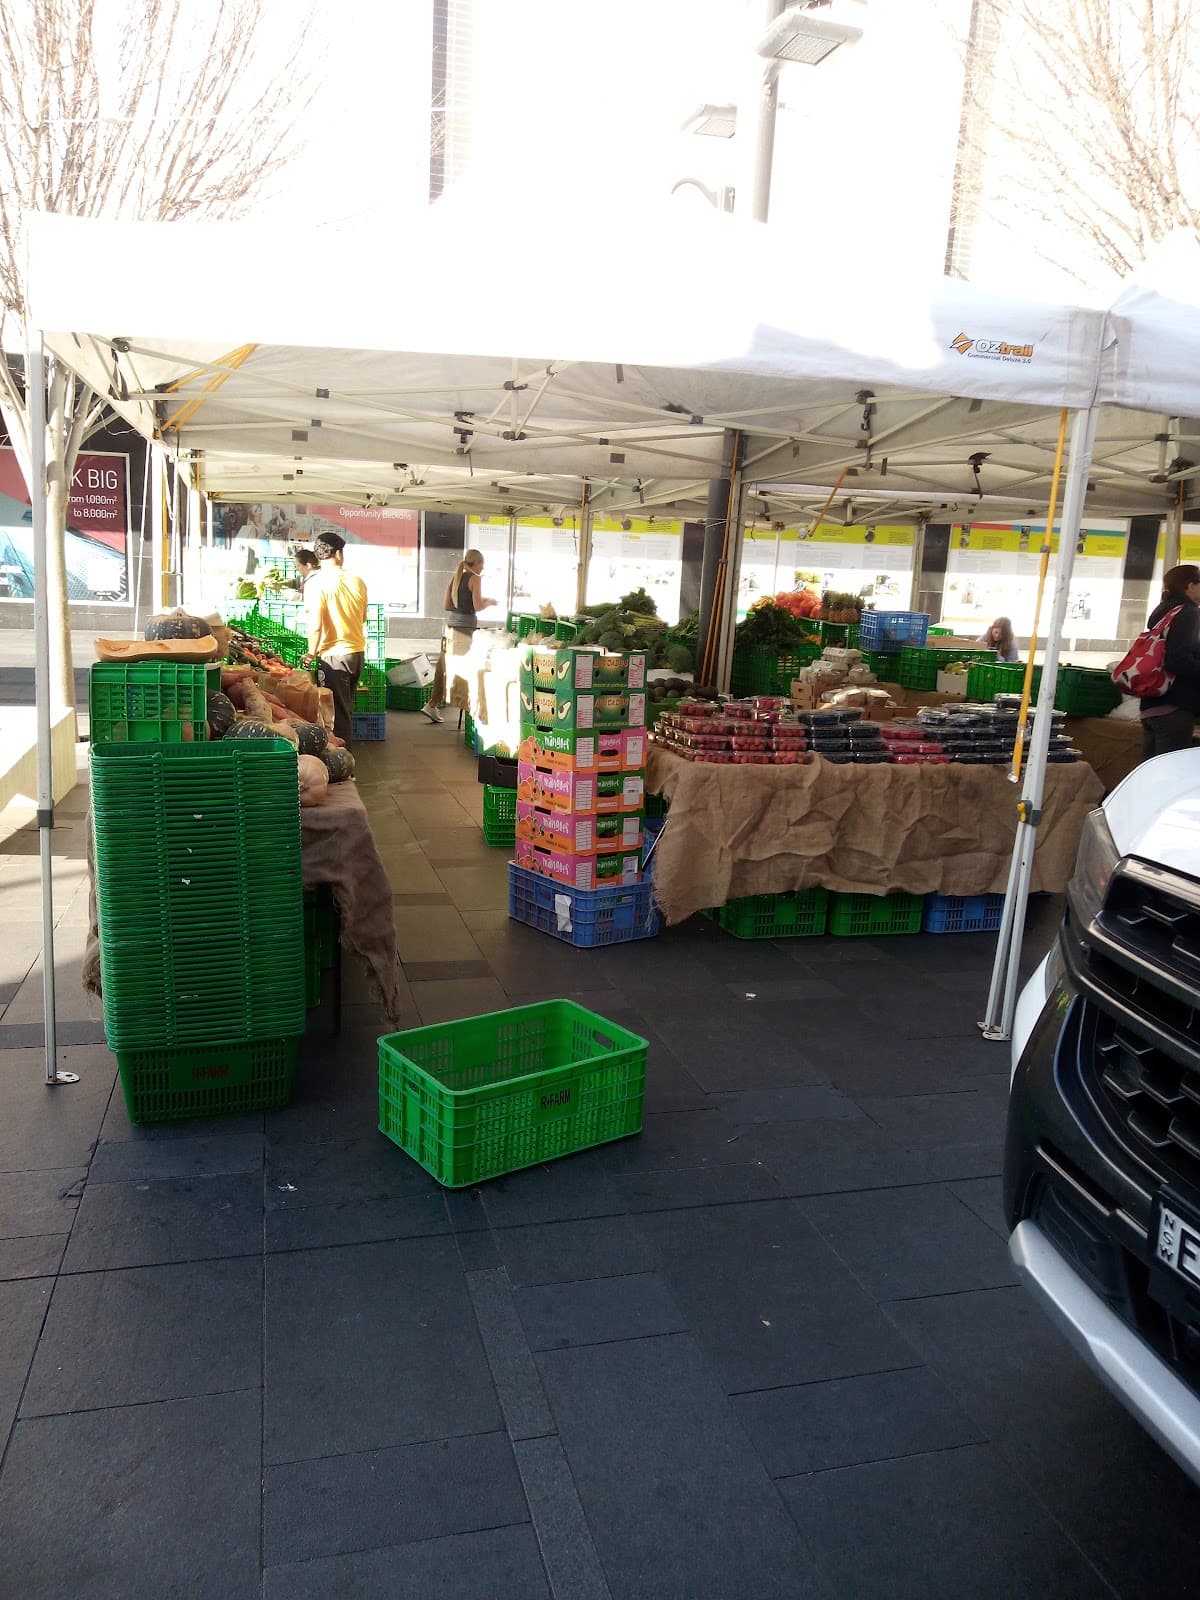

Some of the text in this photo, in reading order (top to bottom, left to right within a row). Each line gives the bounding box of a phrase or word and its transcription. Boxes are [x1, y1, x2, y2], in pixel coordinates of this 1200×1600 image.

[967, 352, 1000, 361] Commercial
[88, 469, 117, 490] BIG
[73, 508, 82, 517] to
[339, 507, 380, 521] Opportunity
